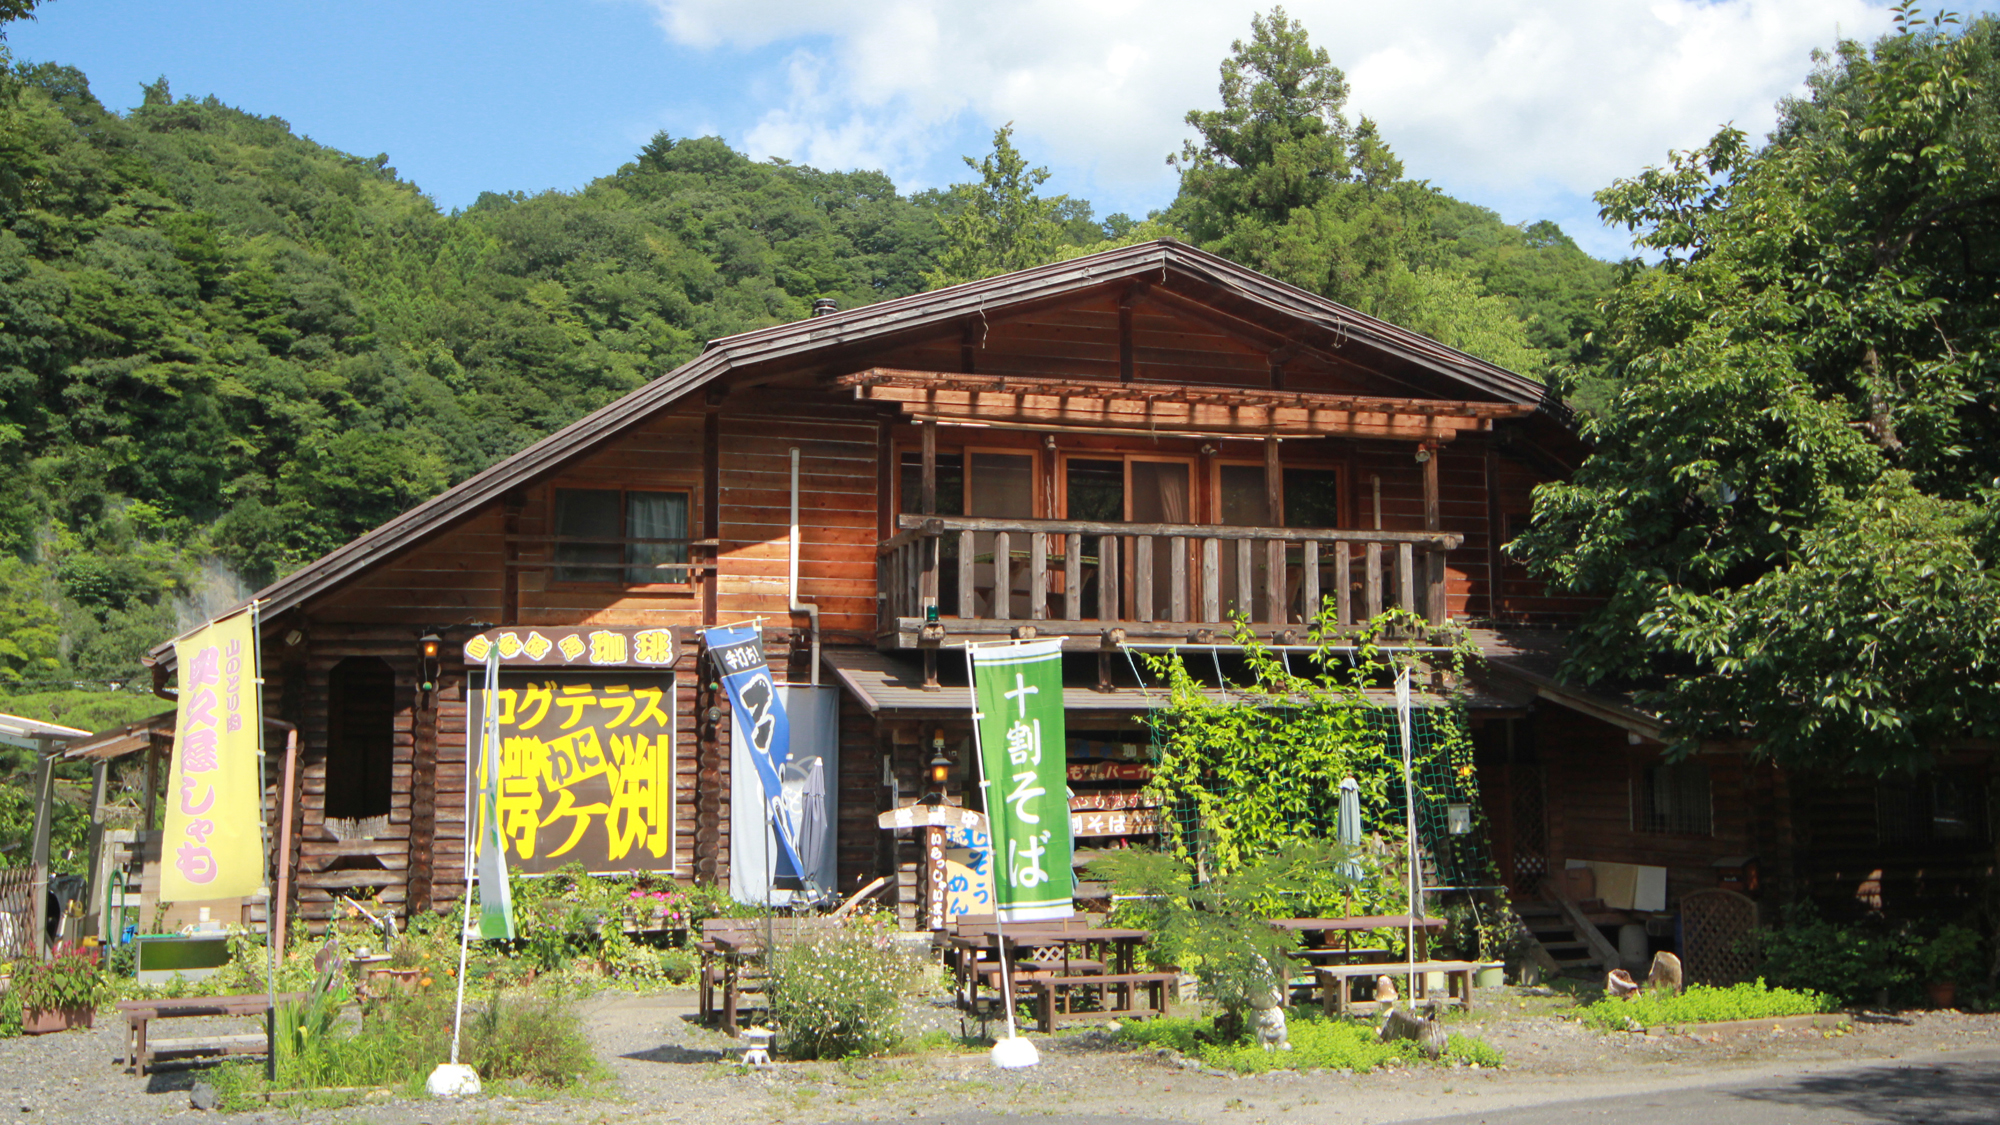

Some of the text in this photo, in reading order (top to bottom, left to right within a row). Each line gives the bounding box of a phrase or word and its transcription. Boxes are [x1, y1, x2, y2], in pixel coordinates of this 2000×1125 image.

[725, 645, 761, 669] 手打ち!
[482, 680, 668, 732] ログテラス
[174, 645, 220, 885] 奥久慈しゃも
[546, 732, 601, 786] わに
[1003, 672, 1050, 888] 十割そば
[895, 806, 980, 828] 営業中
[930, 832, 947, 929] いらっしゃいませ
[948, 874, 969, 915] めん
